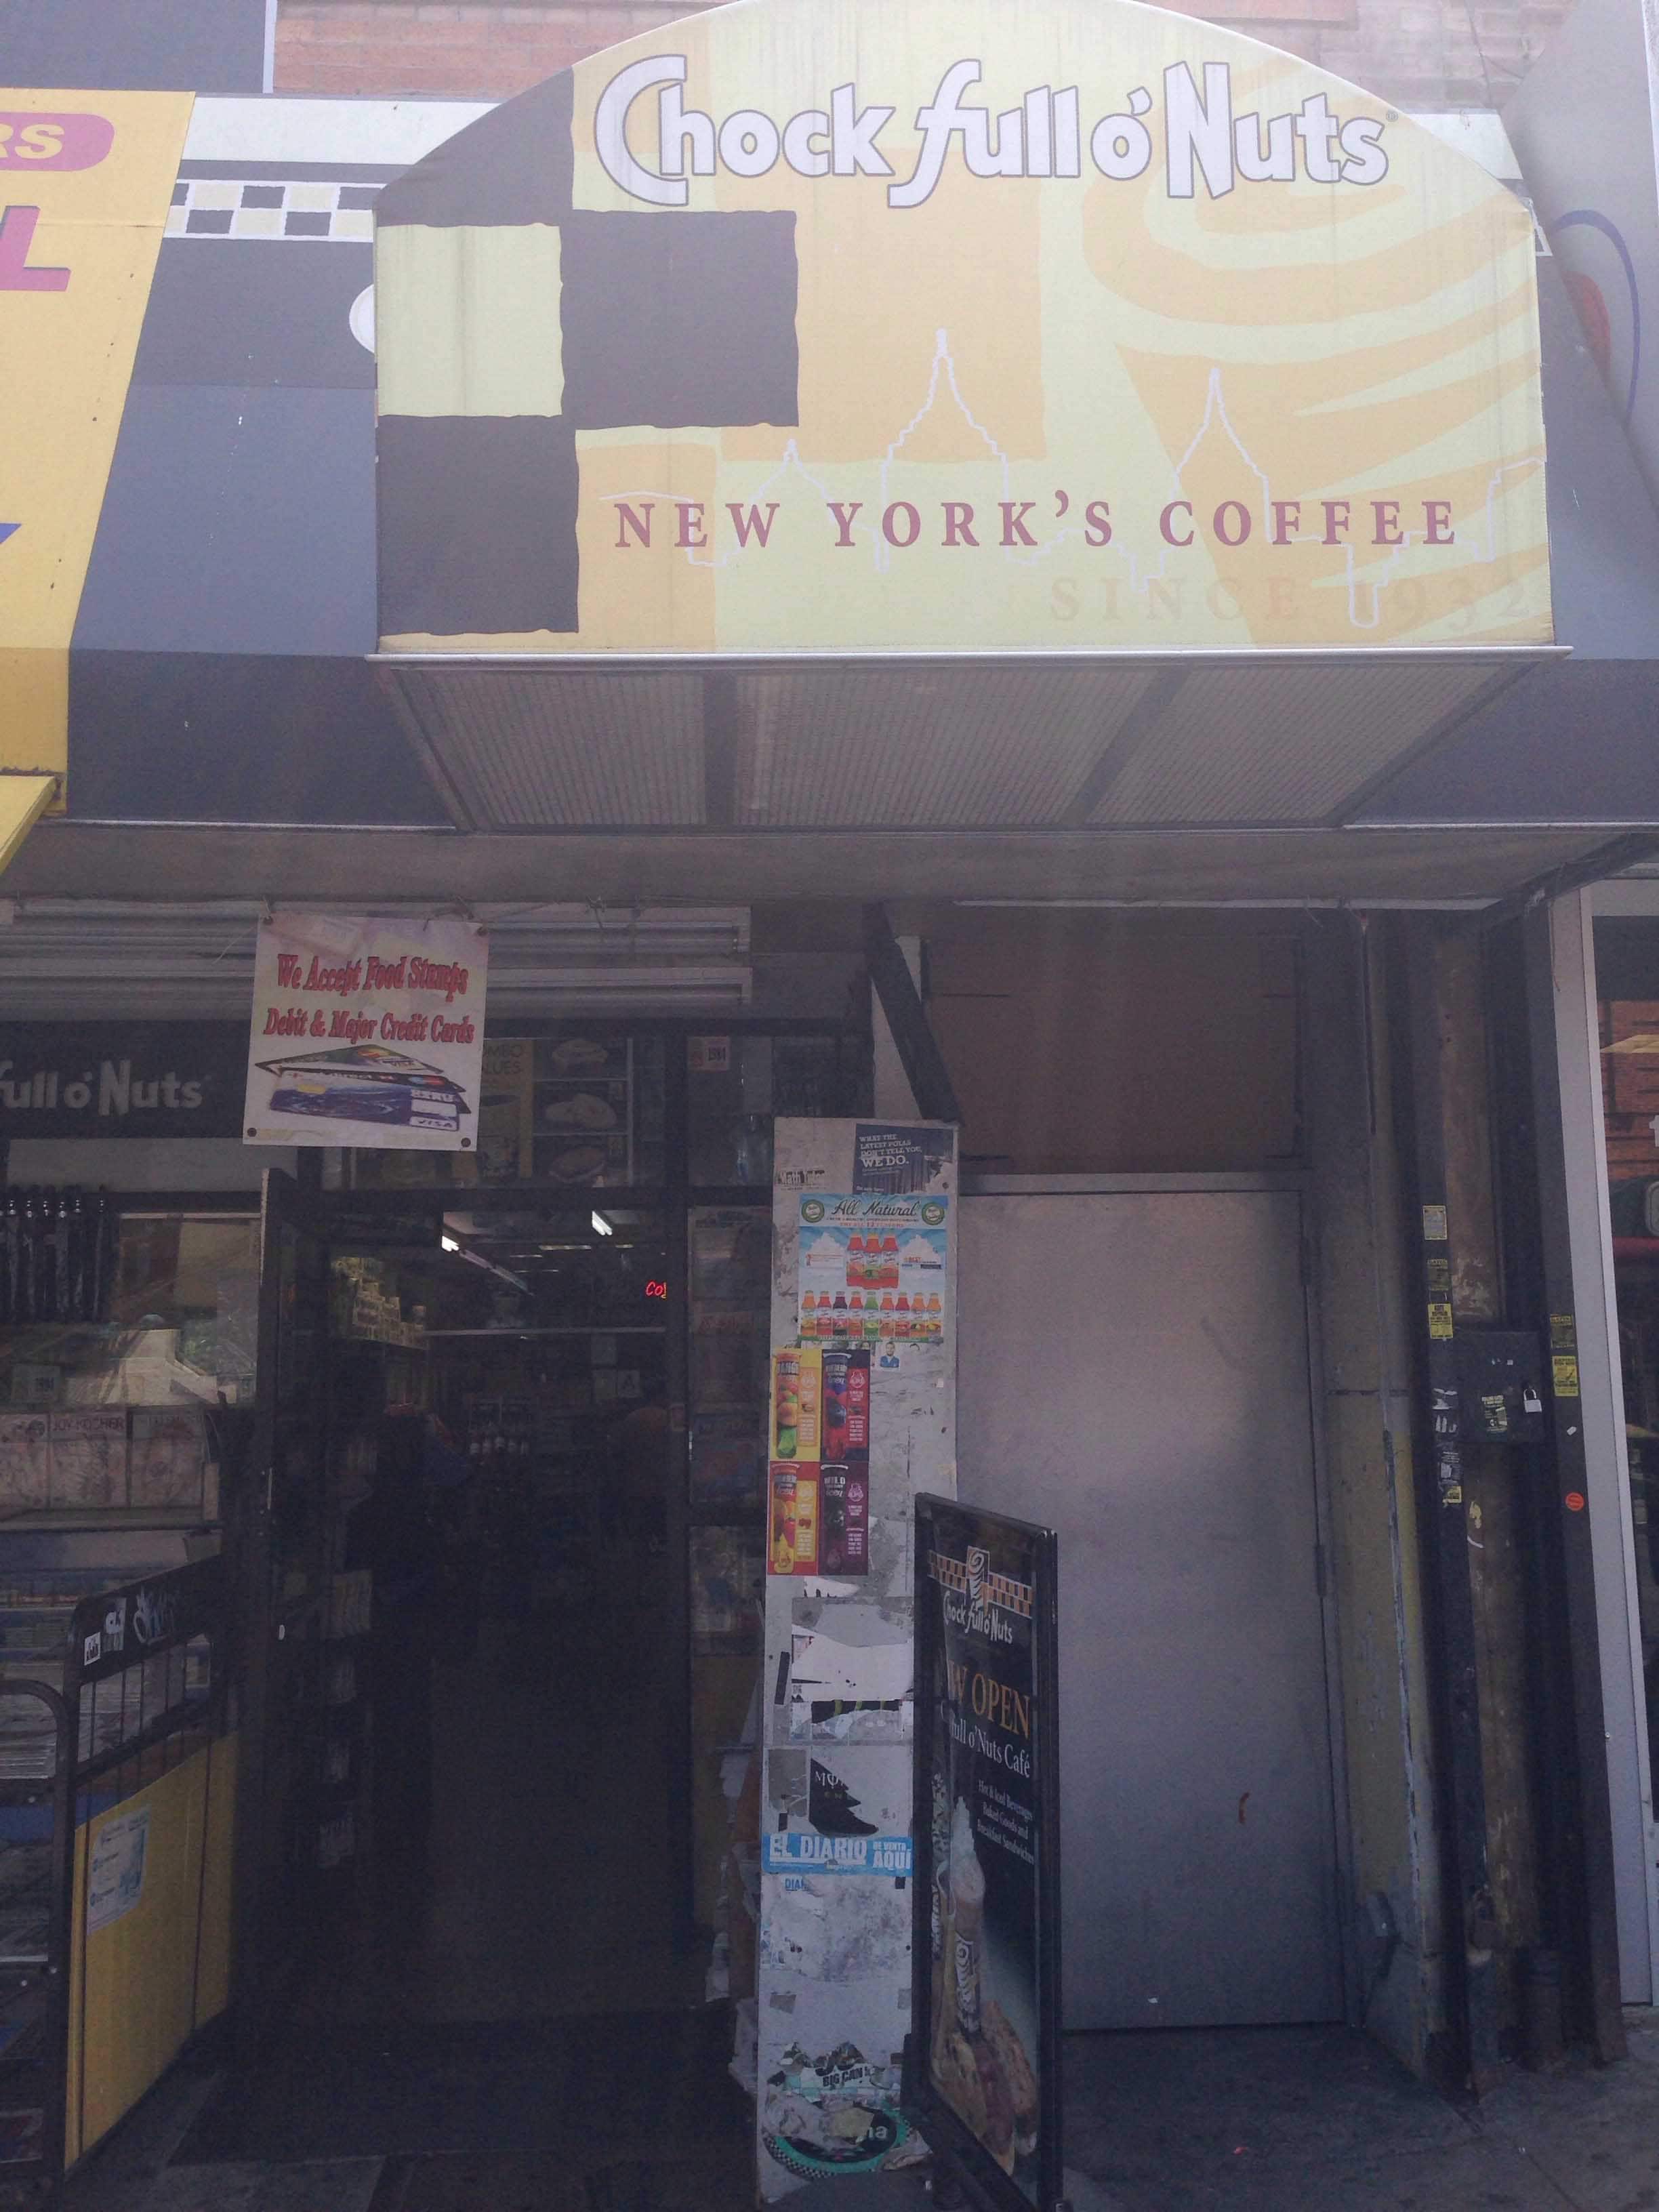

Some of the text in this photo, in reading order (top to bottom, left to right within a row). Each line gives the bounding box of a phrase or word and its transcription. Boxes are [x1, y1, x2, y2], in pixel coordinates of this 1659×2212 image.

[593, 54, 897, 207] Chock
[887, 58, 1081, 208] full
[613, 489, 1456, 548] NEW YORK'S COFFEE
[1050, 575, 1299, 622] SINCE
[277, 954, 469, 1002] We Accept Food Stamps
[263, 1008, 475, 1044] Debit & Major Credit Cards
[862, 1155, 909, 1168] WE DO.
[831, 1199, 921, 1217] All Natural
[943, 1591, 966, 1625] Chock
[964, 1601, 984, 1633] full
[971, 1673, 1031, 1740] OPEN
[1004, 1743, 1031, 1778] Café
[769, 1833, 867, 1861] EL DIARIO
[822, 2074, 840, 2087] BIG
